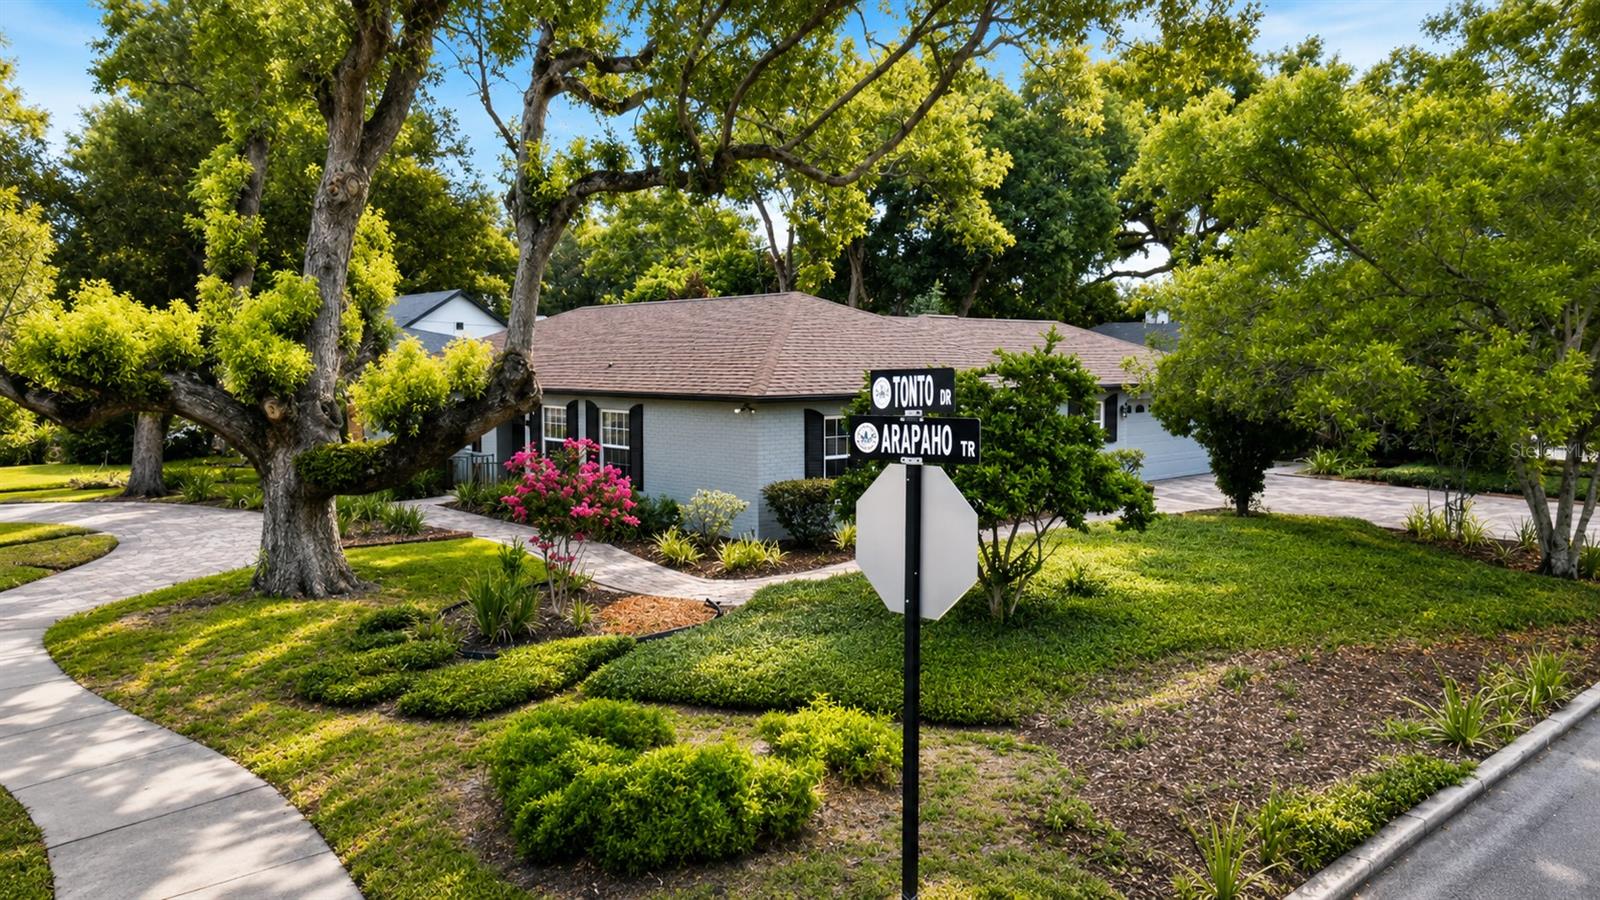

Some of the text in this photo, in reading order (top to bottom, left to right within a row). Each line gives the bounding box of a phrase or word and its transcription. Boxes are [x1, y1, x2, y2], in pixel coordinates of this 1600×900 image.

[893, 375, 934, 408] TONTO
[940, 389, 951, 405] DR
[881, 424, 952, 456] ARAPAHO
[960, 440, 976, 457] TR
